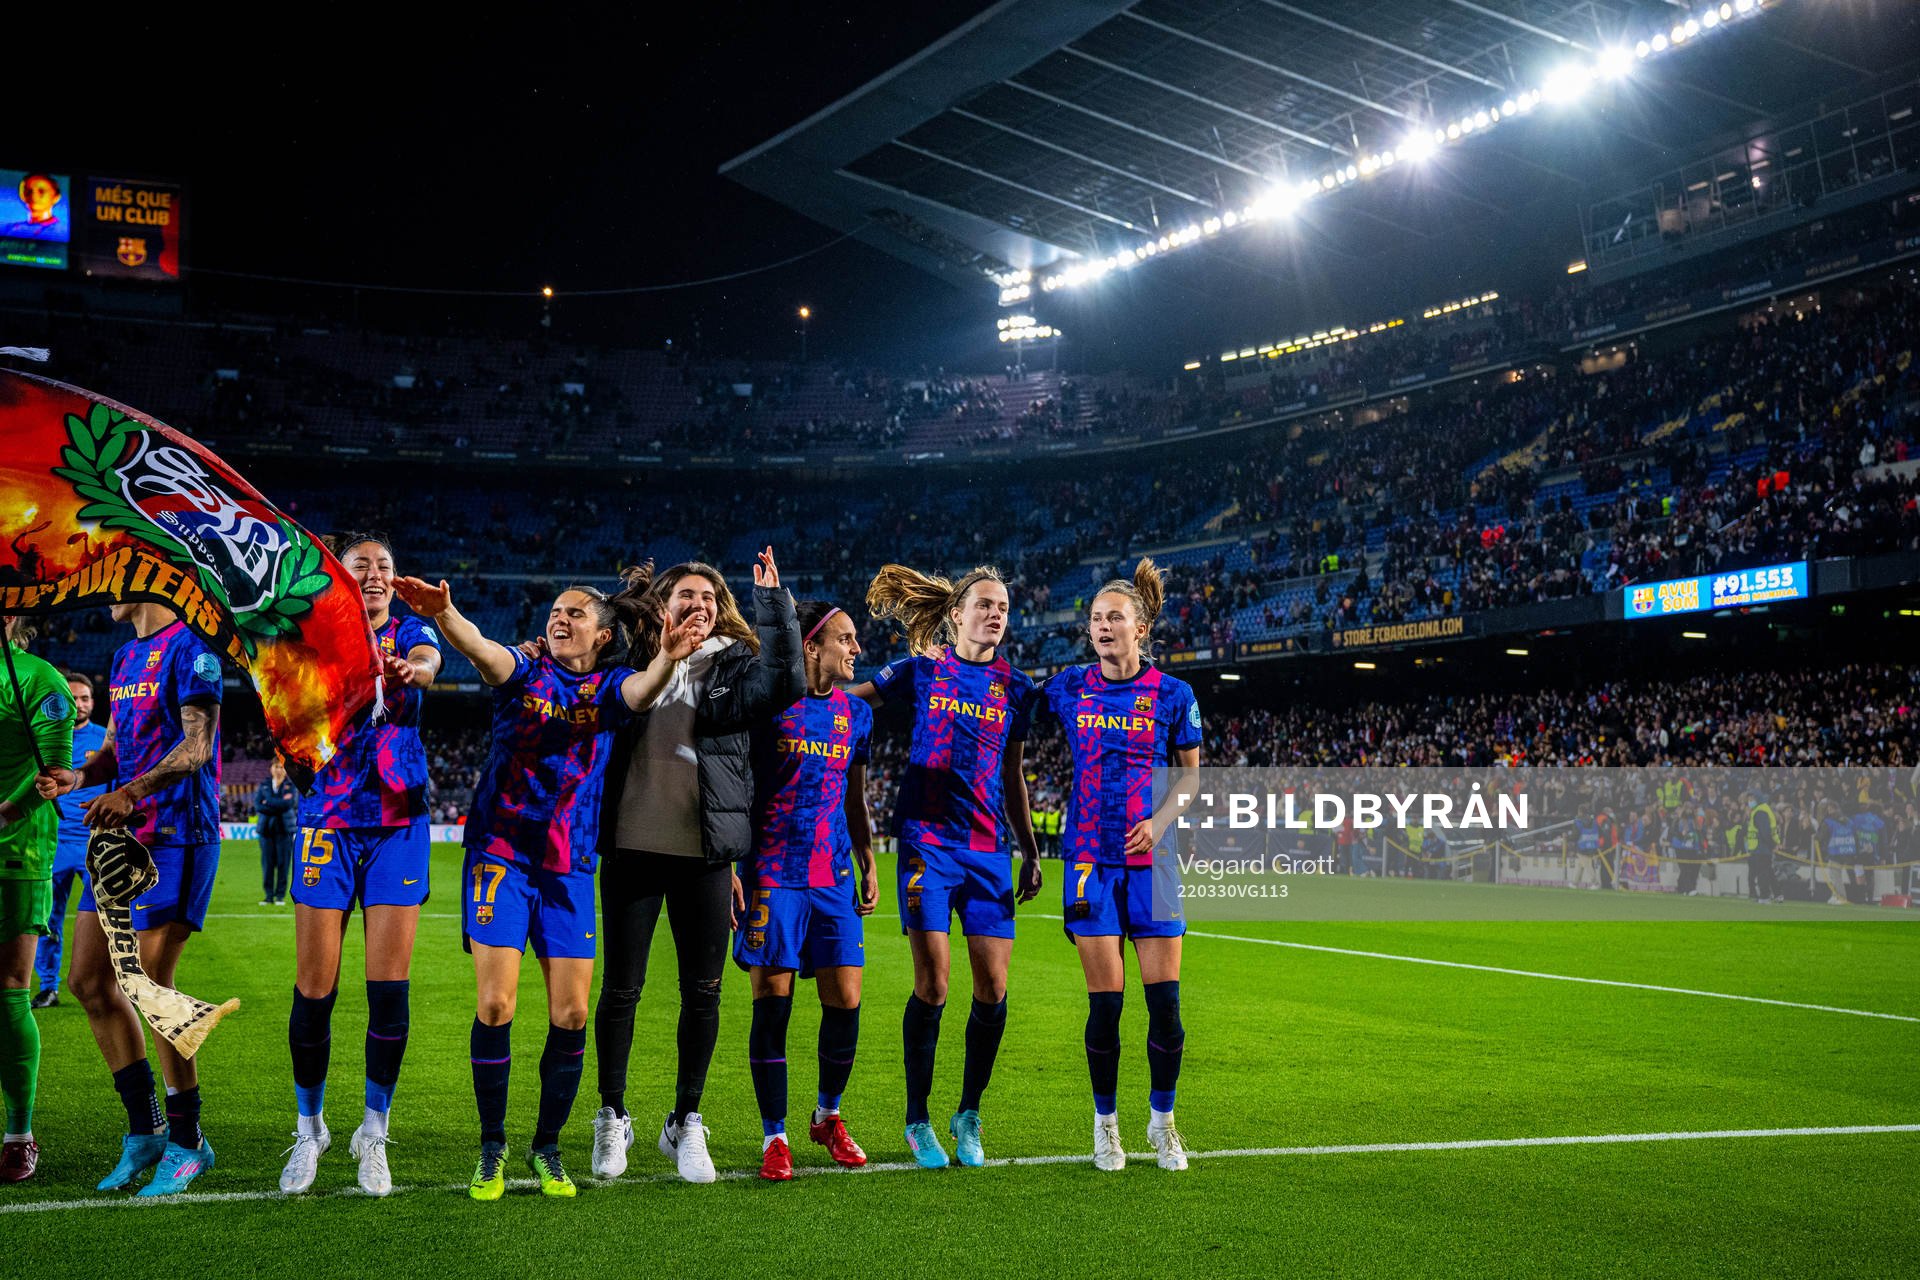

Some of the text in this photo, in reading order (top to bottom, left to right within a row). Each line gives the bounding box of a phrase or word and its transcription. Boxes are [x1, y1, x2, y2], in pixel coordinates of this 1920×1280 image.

[136, 191, 171, 208] QUE
[96, 206, 170, 226] UN CLUB
[0, 547, 221, 637] UPPORTERS
[1658, 579, 1699, 599] AVUI
[1713, 567, 1793, 595] #91.553
[1661, 594, 1699, 613] SOM
[523, 695, 599, 724] STANLEY
[929, 695, 1008, 724] STANLEY
[1077, 714, 1156, 732] STANLEY
[776, 738, 852, 760] STANLEY
[301, 827, 336, 865] 15
[472, 863, 507, 903] 17
[907, 857, 927, 893] 2
[1074, 862, 1093, 898] 7
